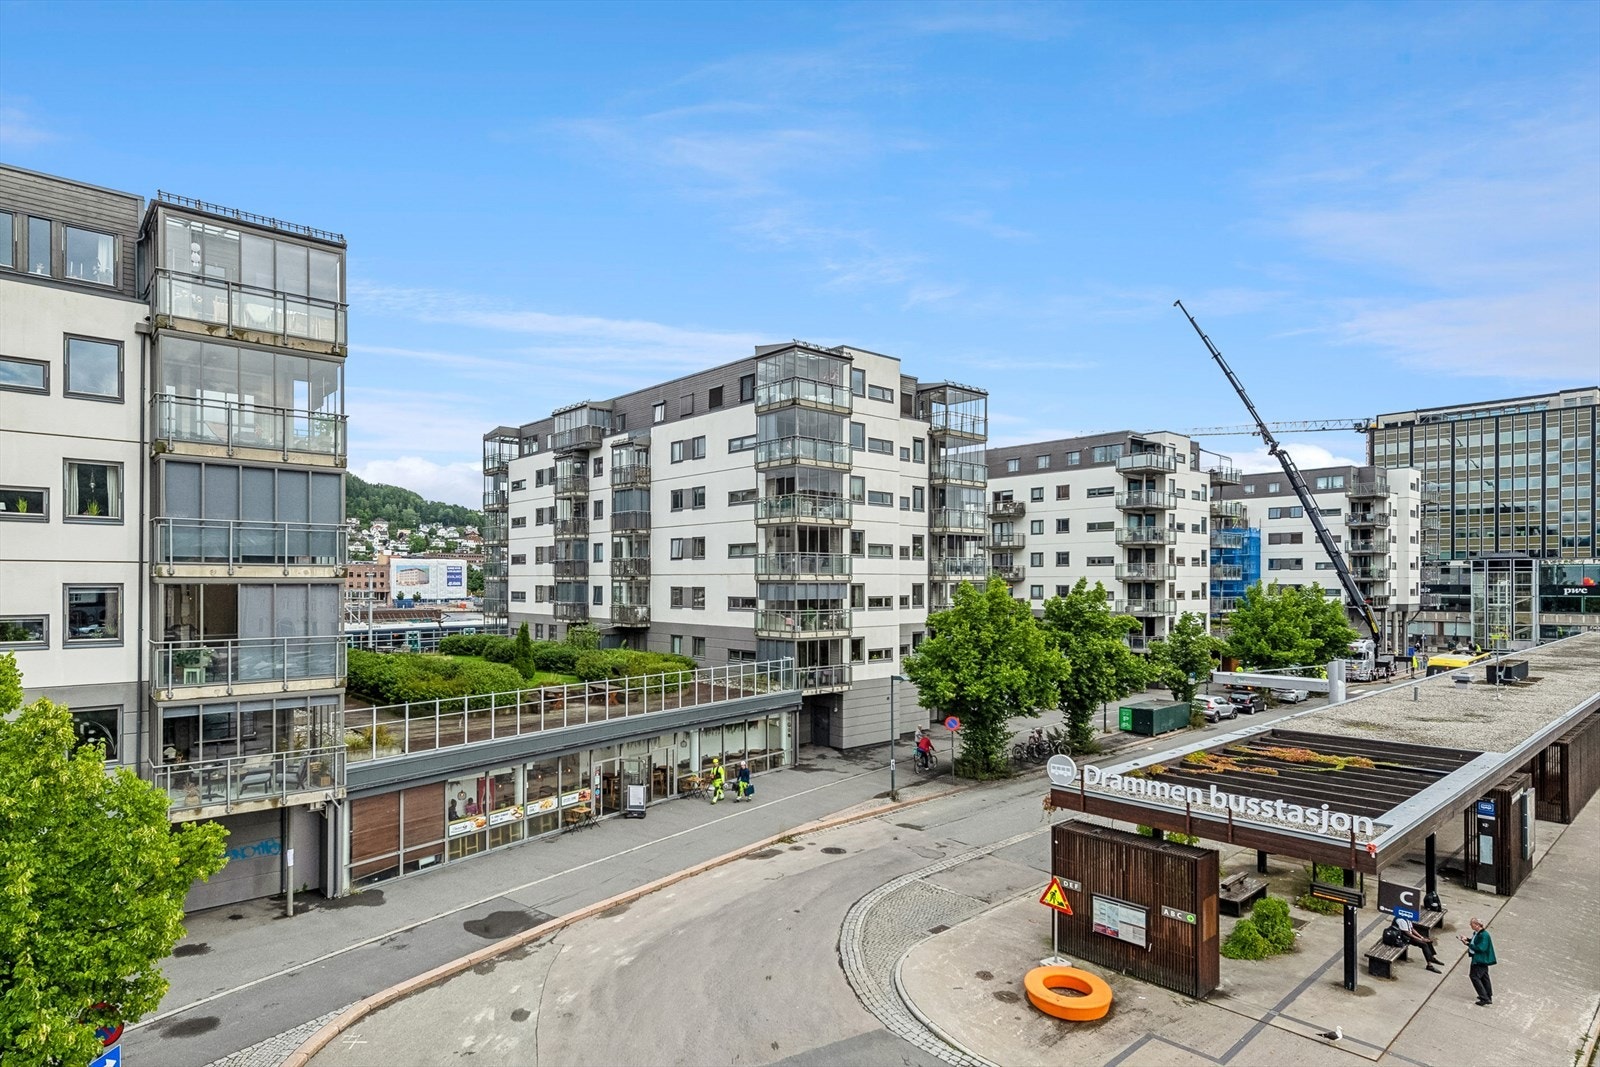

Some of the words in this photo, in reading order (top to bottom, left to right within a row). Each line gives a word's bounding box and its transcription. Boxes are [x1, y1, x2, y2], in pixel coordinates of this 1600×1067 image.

[1083, 764, 1203, 805] Drammen
[1209, 784, 1374, 836] busstasjon
[1399, 891, 1414, 907] C
